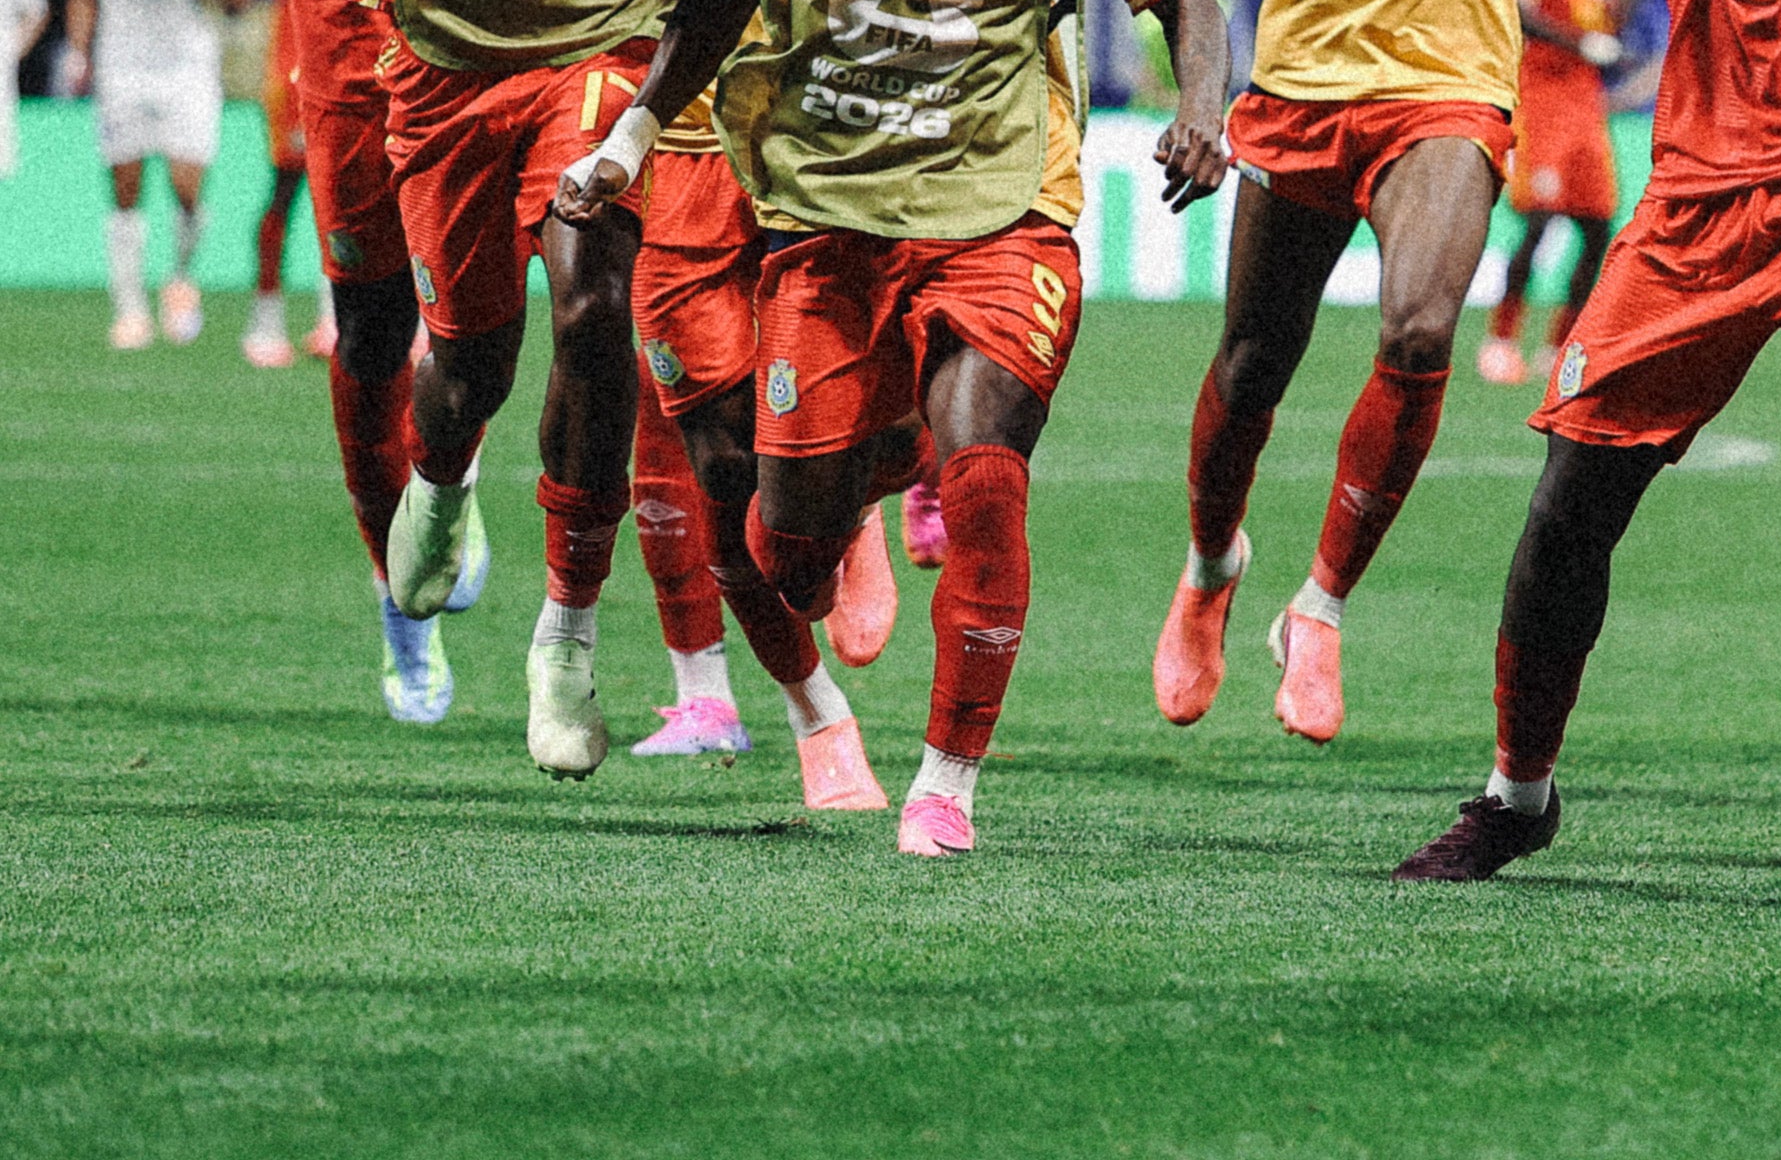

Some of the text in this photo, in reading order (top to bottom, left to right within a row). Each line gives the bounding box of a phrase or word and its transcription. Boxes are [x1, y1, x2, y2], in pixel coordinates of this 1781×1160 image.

[865, 27, 934, 55] FIFA
[812, 57, 961, 103] WORLD CUP
[801, 83, 951, 139] 2026
[1032, 263, 1067, 337] 9
